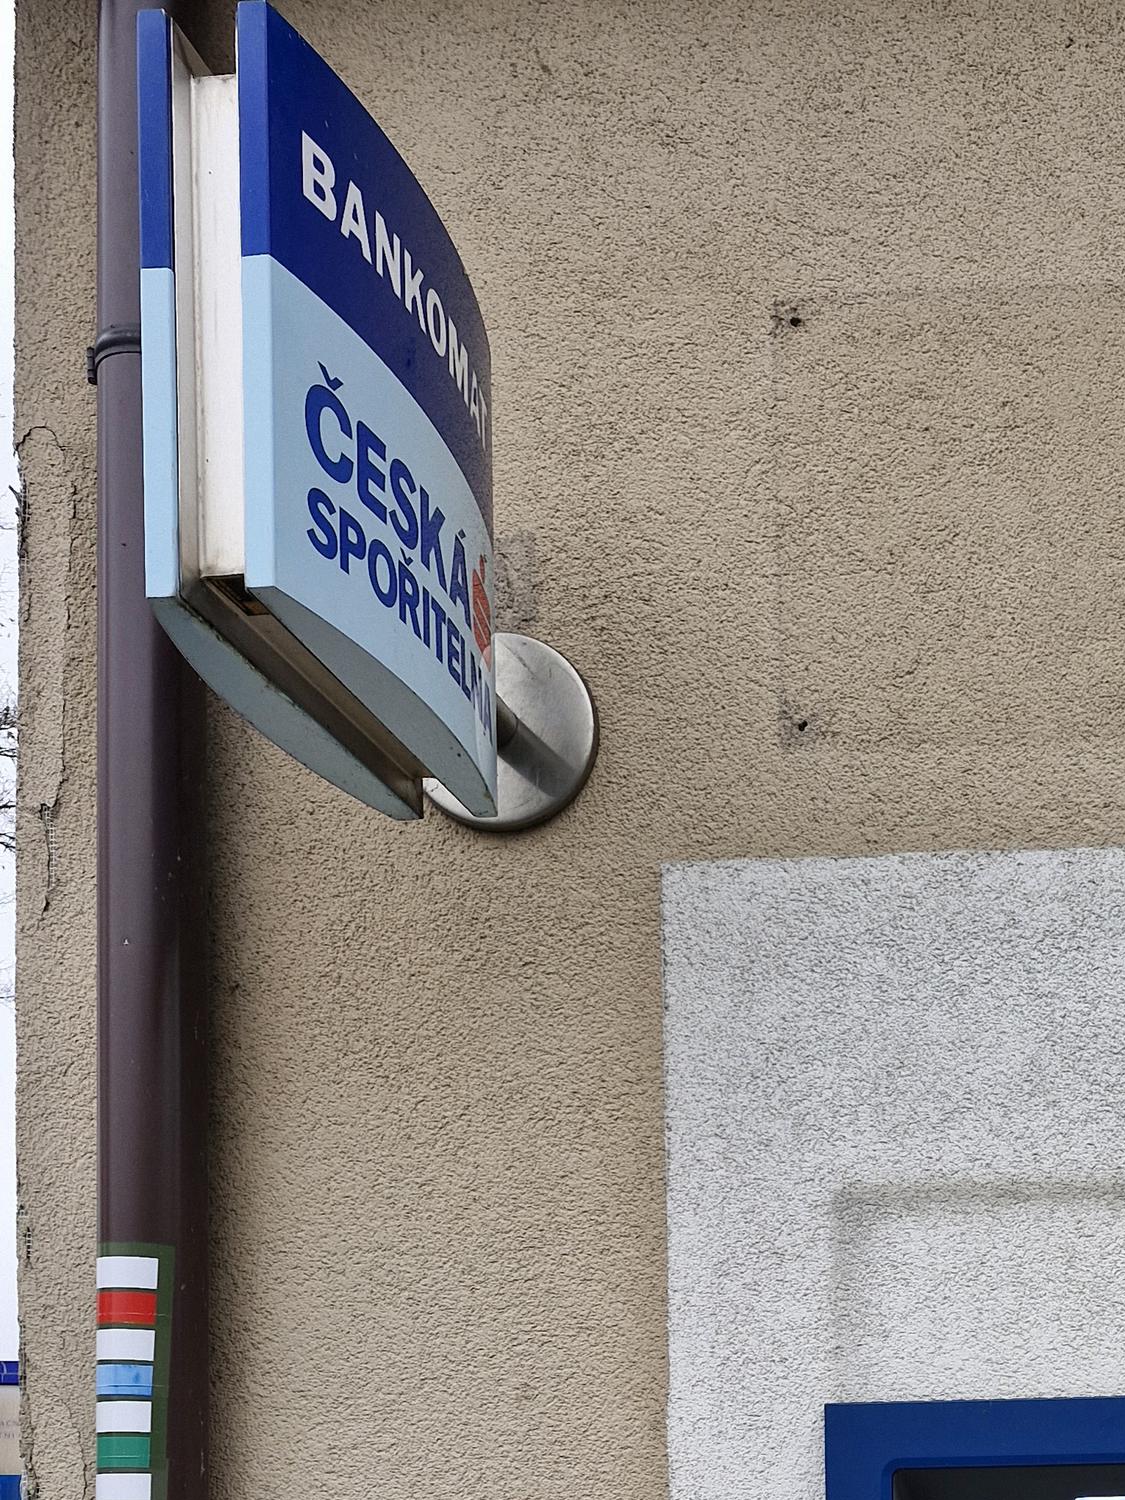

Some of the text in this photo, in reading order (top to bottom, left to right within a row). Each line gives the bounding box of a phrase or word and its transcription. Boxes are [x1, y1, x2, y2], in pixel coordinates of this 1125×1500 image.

[302, 130, 488, 451] BANKOMAT
[304, 361, 472, 632] ČESKÁ
[306, 487, 493, 747] SPOŘITELNA
